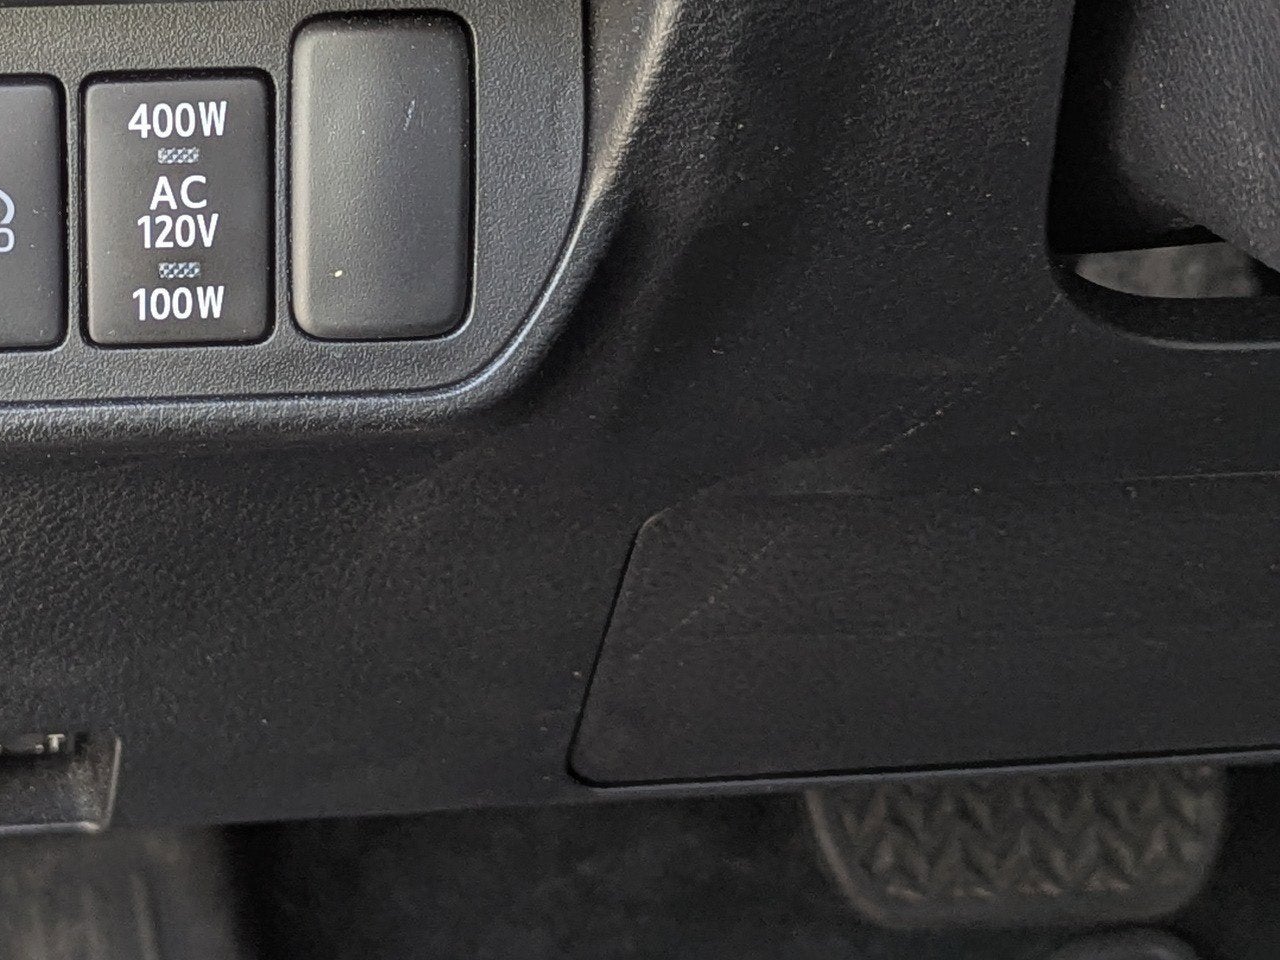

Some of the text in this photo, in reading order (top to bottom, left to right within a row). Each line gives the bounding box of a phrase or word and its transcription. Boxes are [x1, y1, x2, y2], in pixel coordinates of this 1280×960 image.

[127, 100, 228, 139] 400W
[149, 174, 208, 211] AC
[136, 213, 219, 249] 120V
[132, 285, 225, 321] 100W
